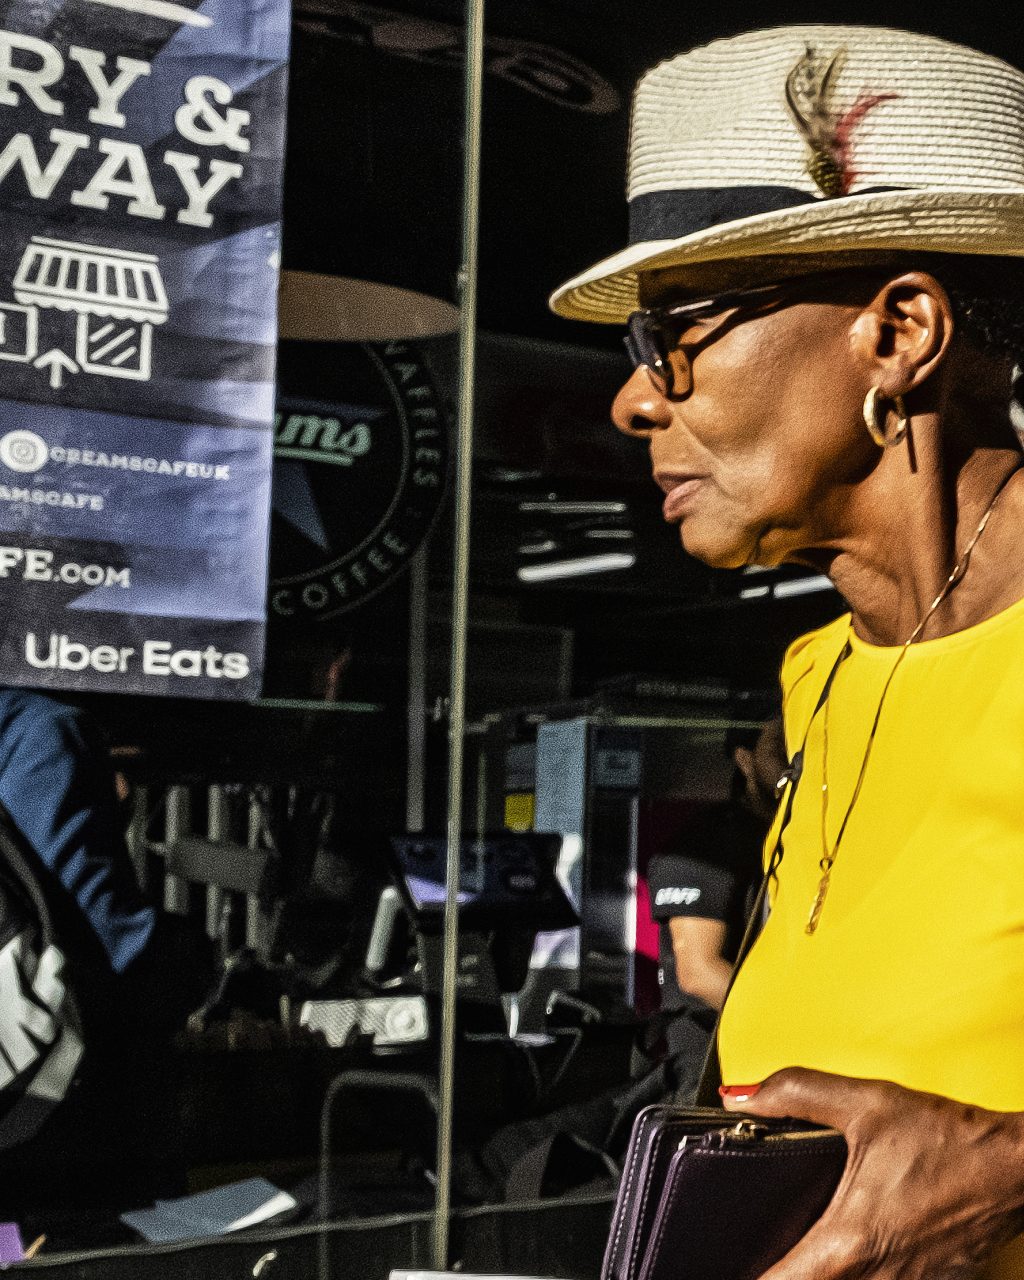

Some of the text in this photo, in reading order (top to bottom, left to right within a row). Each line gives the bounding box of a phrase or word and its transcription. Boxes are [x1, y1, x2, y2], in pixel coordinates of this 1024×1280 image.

[174, 75, 250, 152] &
[272, 531, 409, 616] COFFEE
[25, 632, 249, 679] Uber Eats
